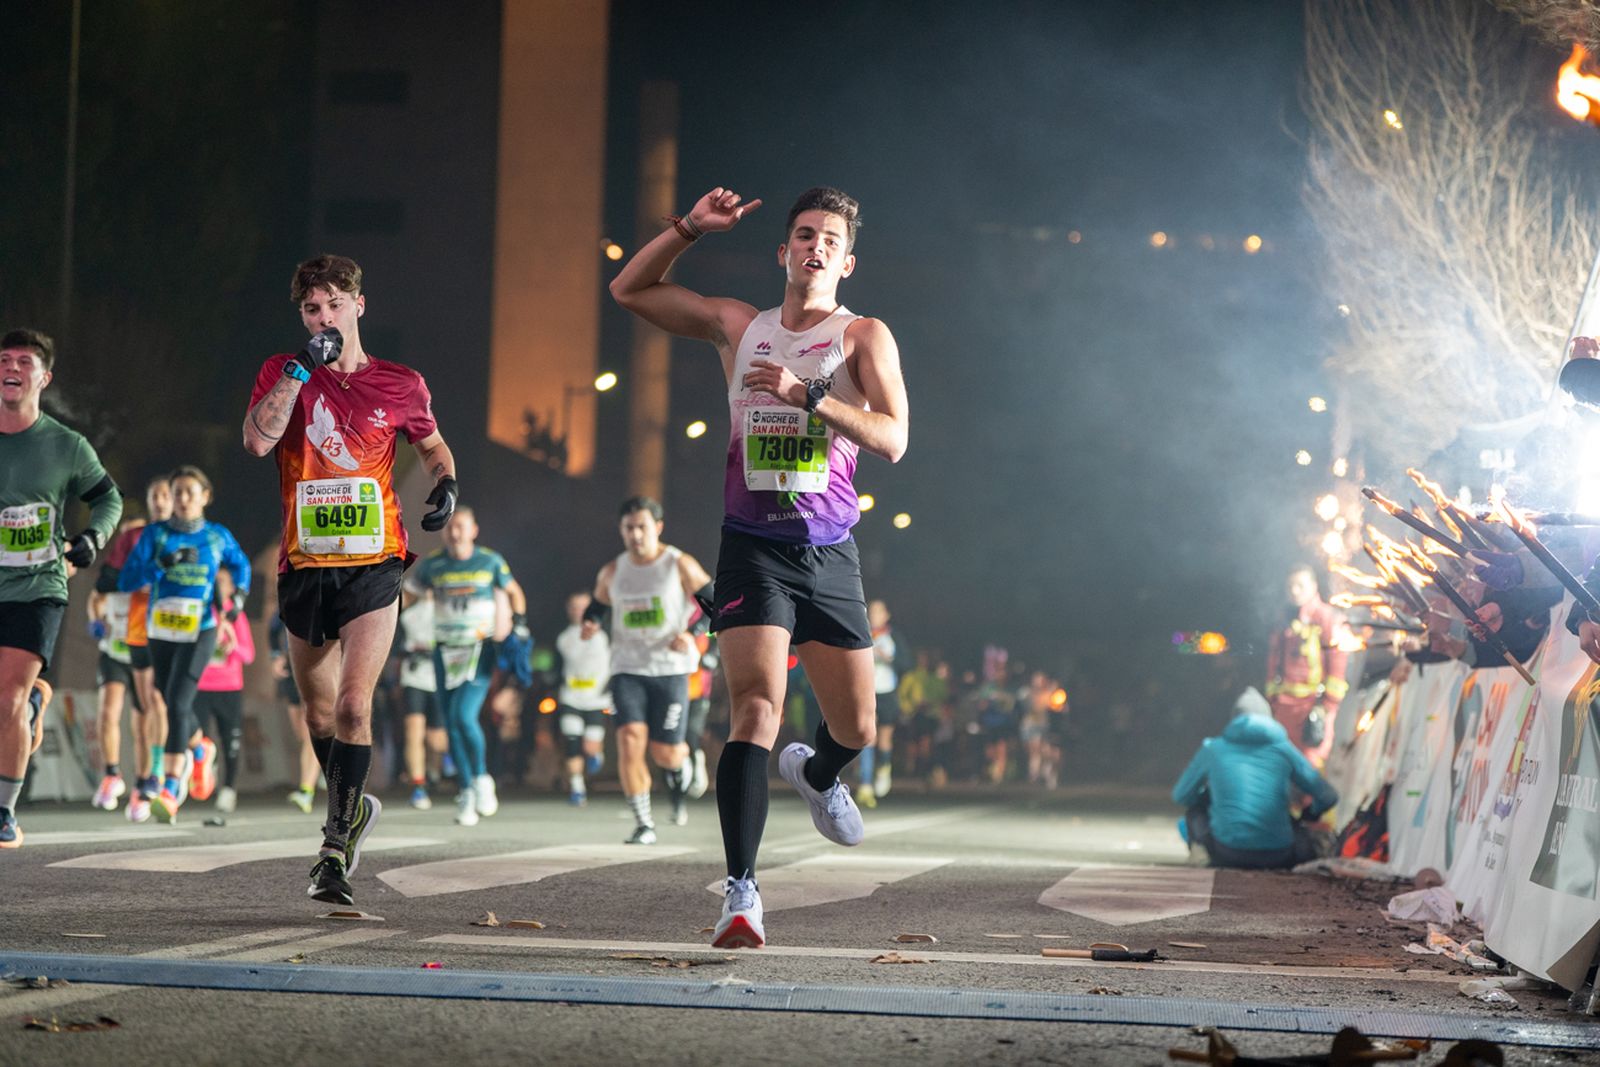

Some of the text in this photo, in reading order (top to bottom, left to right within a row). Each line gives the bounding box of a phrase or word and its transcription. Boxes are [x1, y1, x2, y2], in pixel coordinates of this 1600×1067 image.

[752, 425, 768, 435] SAN
[769, 425, 799, 435] ANTÓN
[761, 415, 800, 425] NOCHE DE
[320, 436, 343, 458] 43
[758, 437, 813, 462] 7306
[306, 497, 323, 506] SAN
[325, 495, 353, 505] ANTÓN
[316, 486, 352, 495] NOCHE DE
[315, 505, 368, 529] 6497
[9, 525, 44, 546] 7035
[343, 786, 358, 820] Reebok
